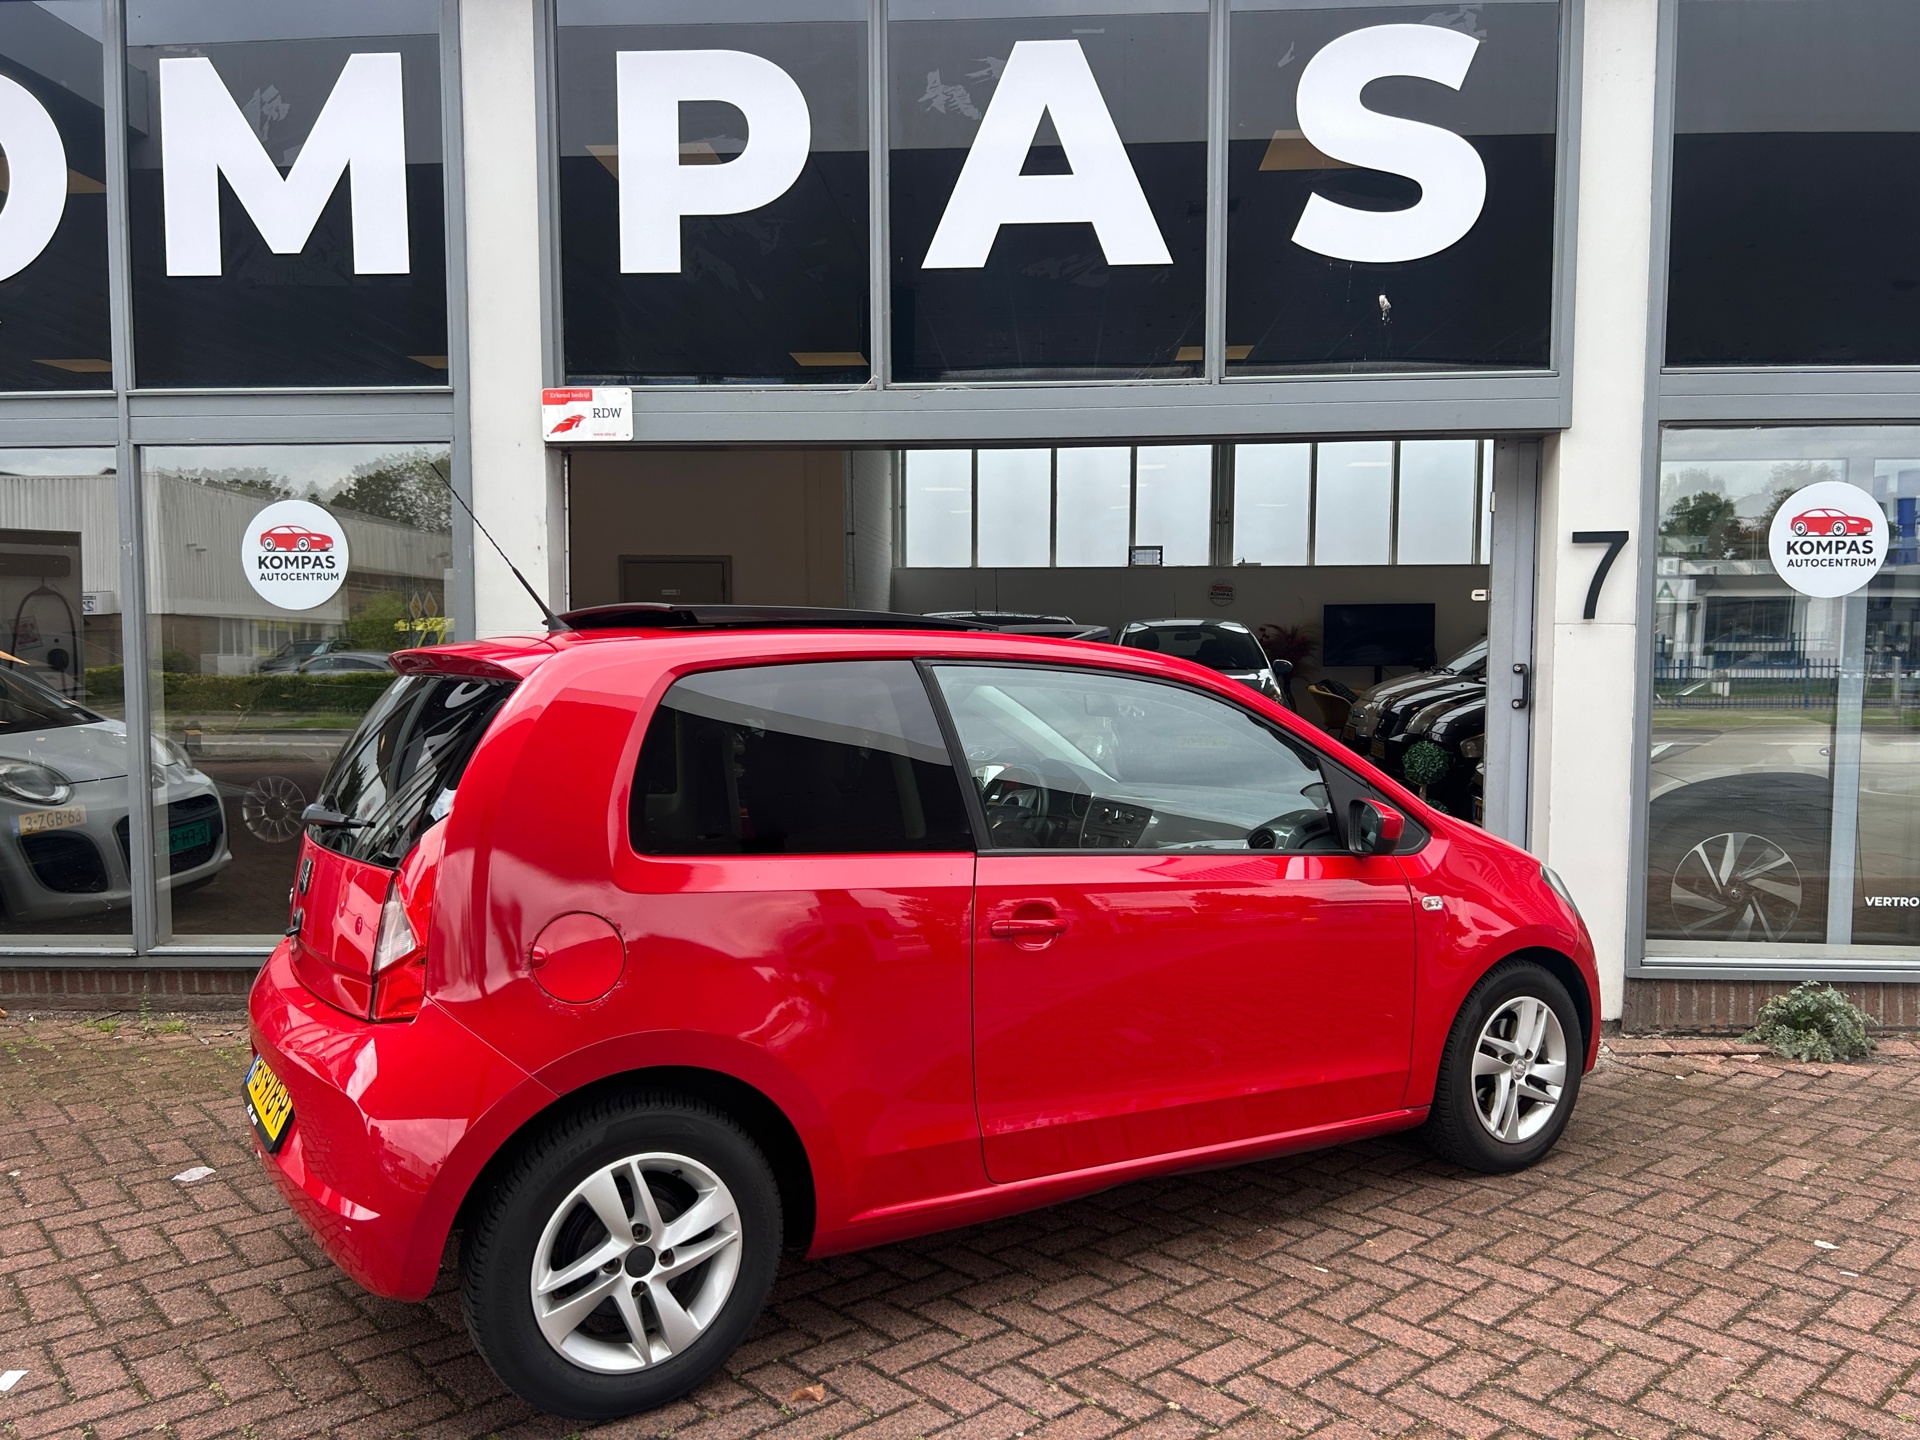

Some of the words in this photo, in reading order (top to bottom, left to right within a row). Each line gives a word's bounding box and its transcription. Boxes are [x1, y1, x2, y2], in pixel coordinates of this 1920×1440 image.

[592, 408, 622, 418] RDW
[1786, 540, 1874, 555] KOMPAS
[258, 555, 336, 570] KOMPAS
[1787, 558, 1877, 567] AUTOCENTRUM
[260, 572, 339, 581] AUTOCENTRUM
[1572, 531, 1629, 619] 7
[25, 808, 82, 832] 3-ZGB-63
[1865, 896, 1920, 907] VERTRO
